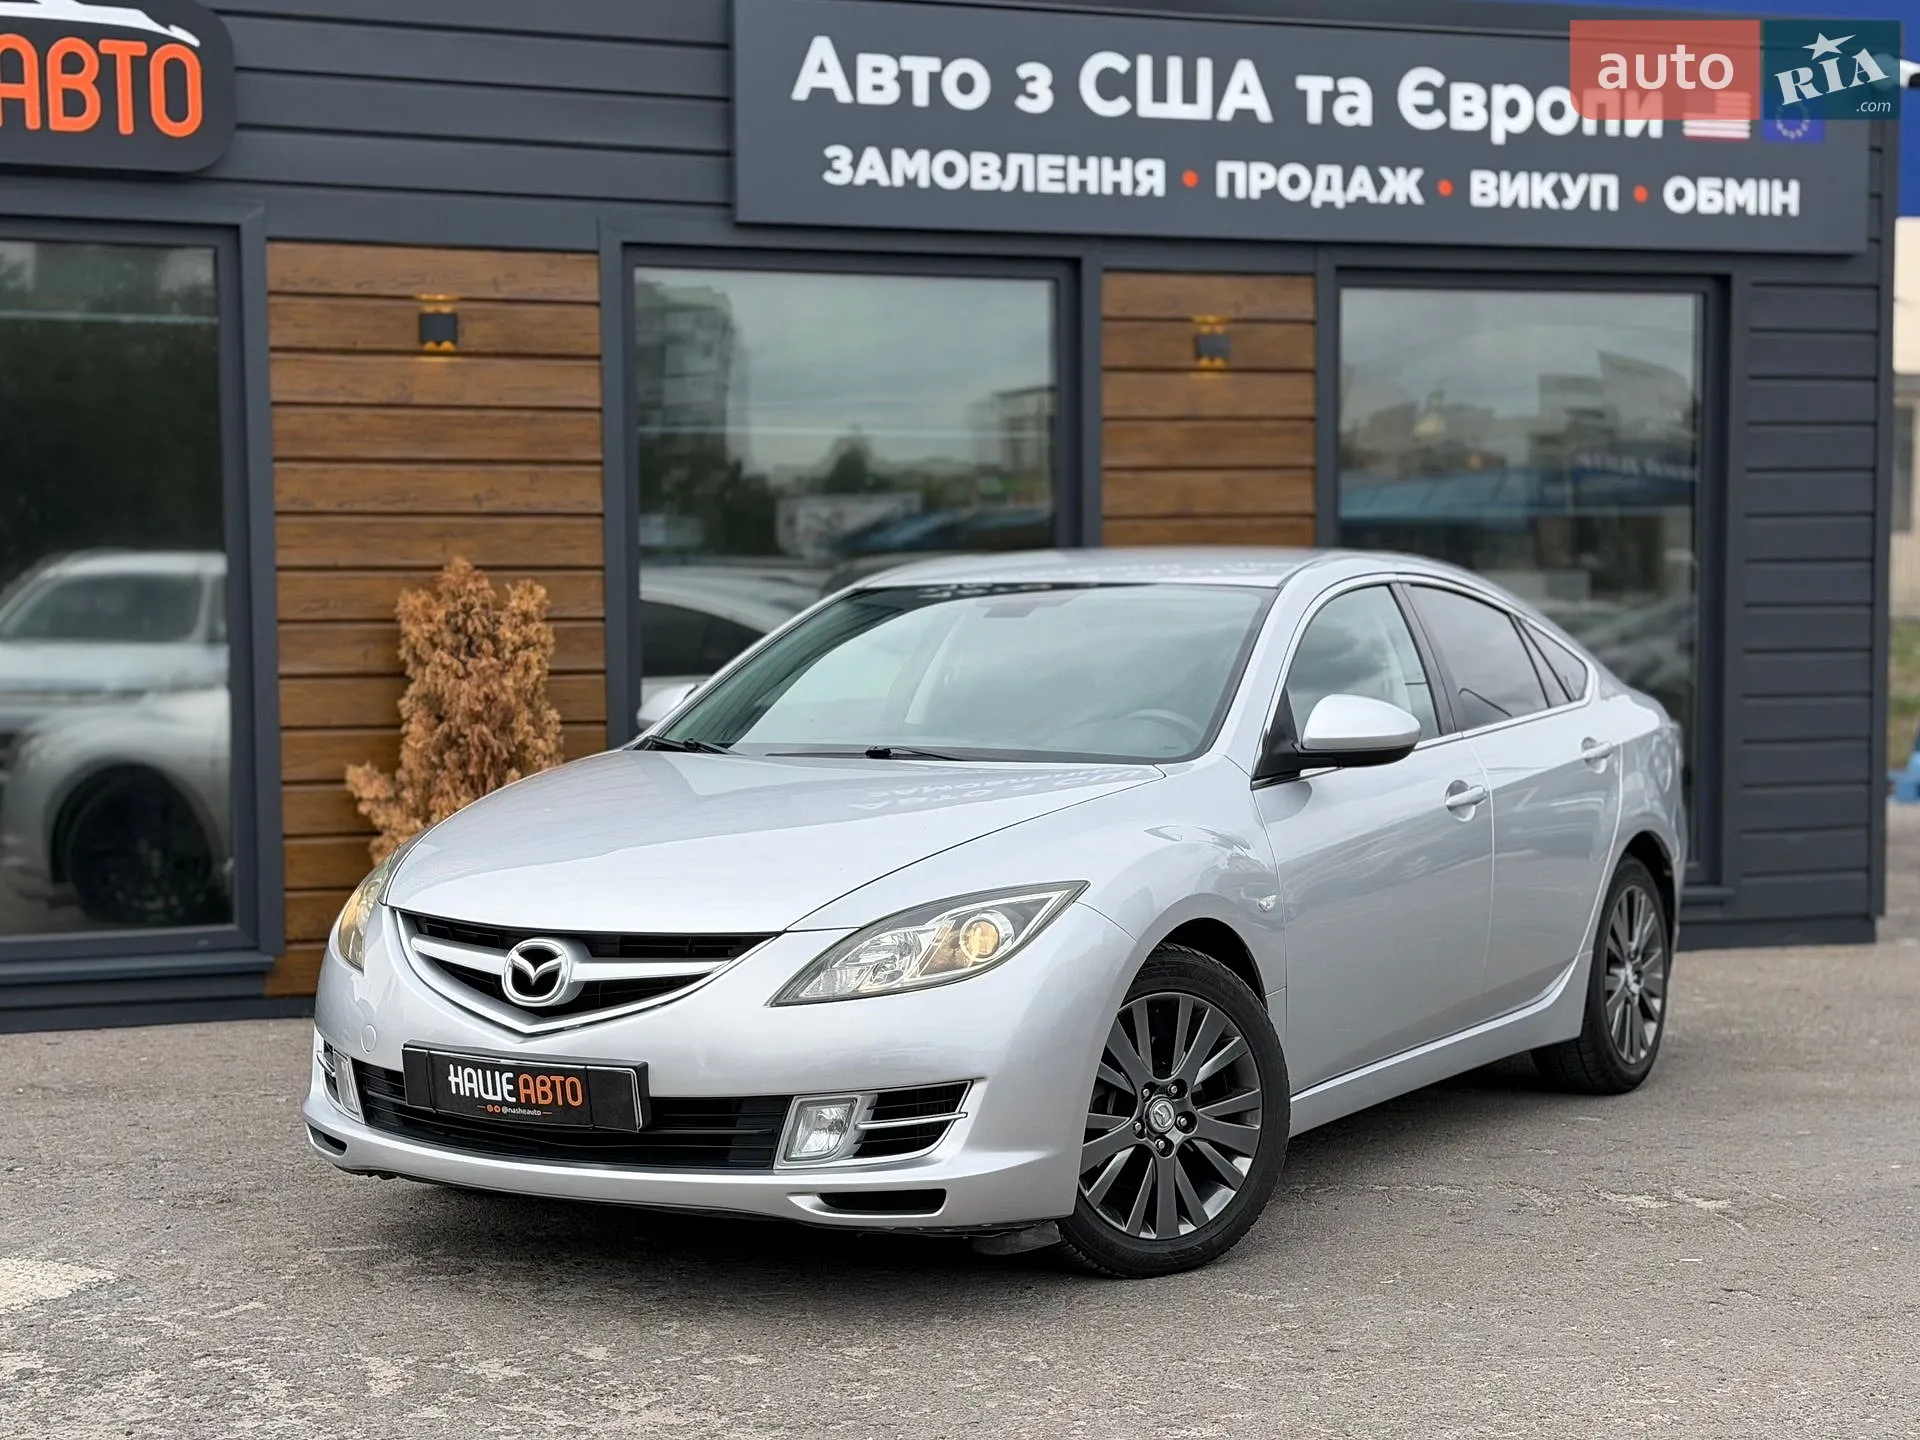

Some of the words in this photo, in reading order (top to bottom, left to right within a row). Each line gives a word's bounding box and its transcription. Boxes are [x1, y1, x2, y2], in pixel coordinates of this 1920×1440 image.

[0, 34, 203, 138] АВТО
[791, 35, 992, 111] Авто
[1014, 61, 1054, 114] з
[1078, 51, 1274, 124] США
[1295, 74, 1373, 127] та
[1397, 66, 1664, 146] Європи
[822, 144, 1166, 197] ЗАМОВЛЕННЯ
[1215, 160, 1425, 209] ПРОДАЖ
[1469, 169, 1620, 212] ВИКУП
[1663, 175, 1800, 217] ОБМІН
[518, 1073, 584, 1108] АВТО
